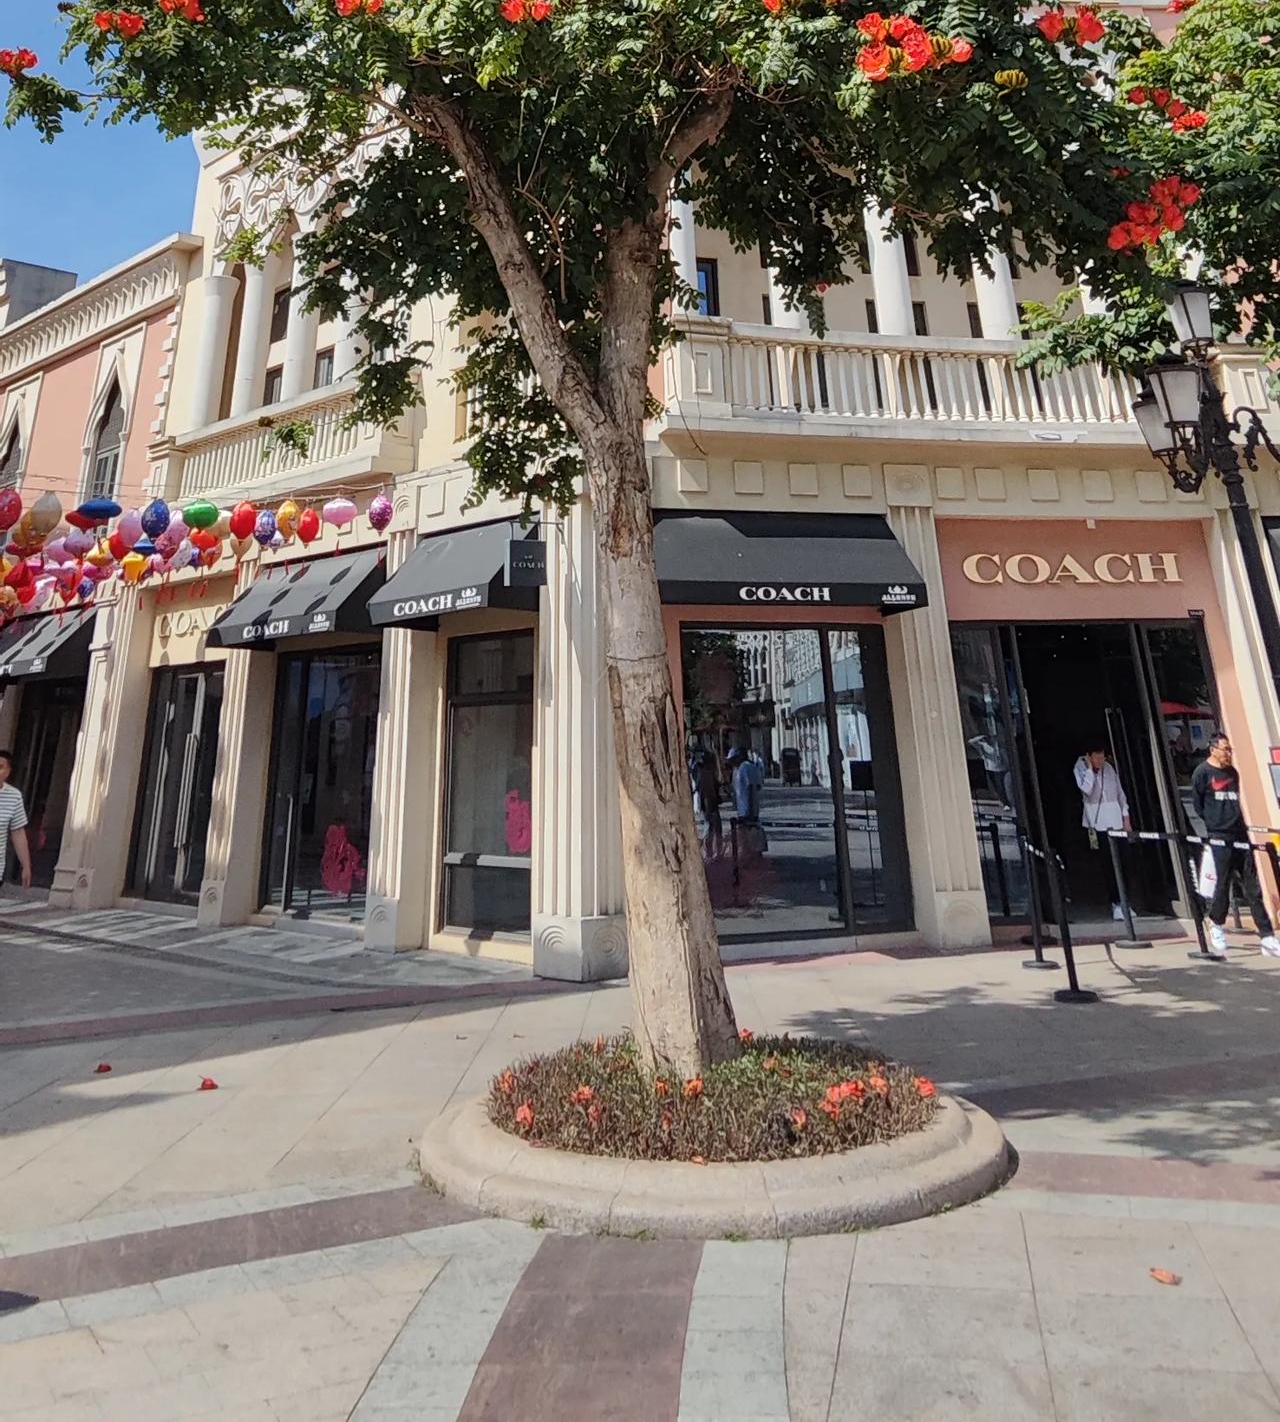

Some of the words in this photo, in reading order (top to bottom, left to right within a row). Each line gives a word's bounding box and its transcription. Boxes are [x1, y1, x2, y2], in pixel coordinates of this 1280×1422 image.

[962, 552, 1184, 585] COACH
[393, 593, 454, 617] COACH
[739, 586, 832, 602] COACH
[242, 619, 290, 640] COACH
